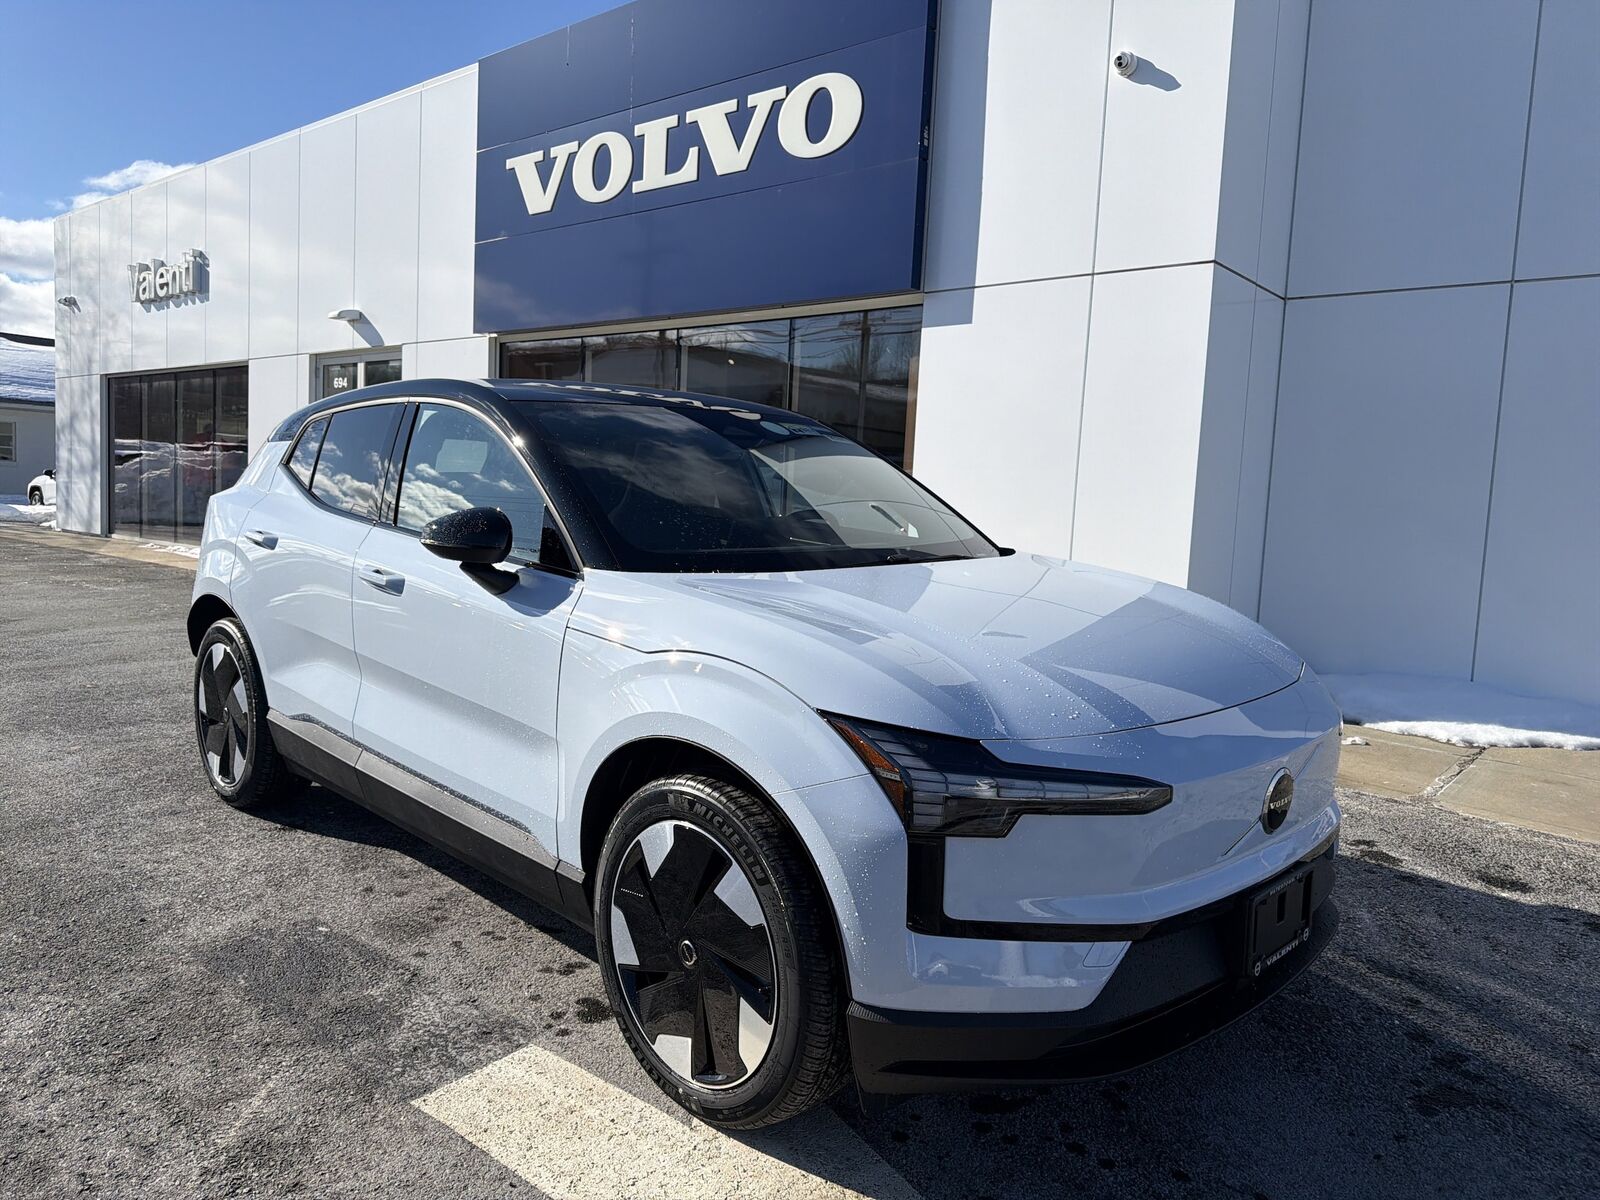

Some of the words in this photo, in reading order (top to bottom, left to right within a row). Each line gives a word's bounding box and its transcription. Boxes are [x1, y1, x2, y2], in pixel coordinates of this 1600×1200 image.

[505, 72, 864, 216] VOLVO
[127, 248, 203, 303] Valenti
[333, 377, 348, 389] 694
[692, 802, 767, 880] MICHELIN
[1266, 938, 1300, 966] VALENTI
